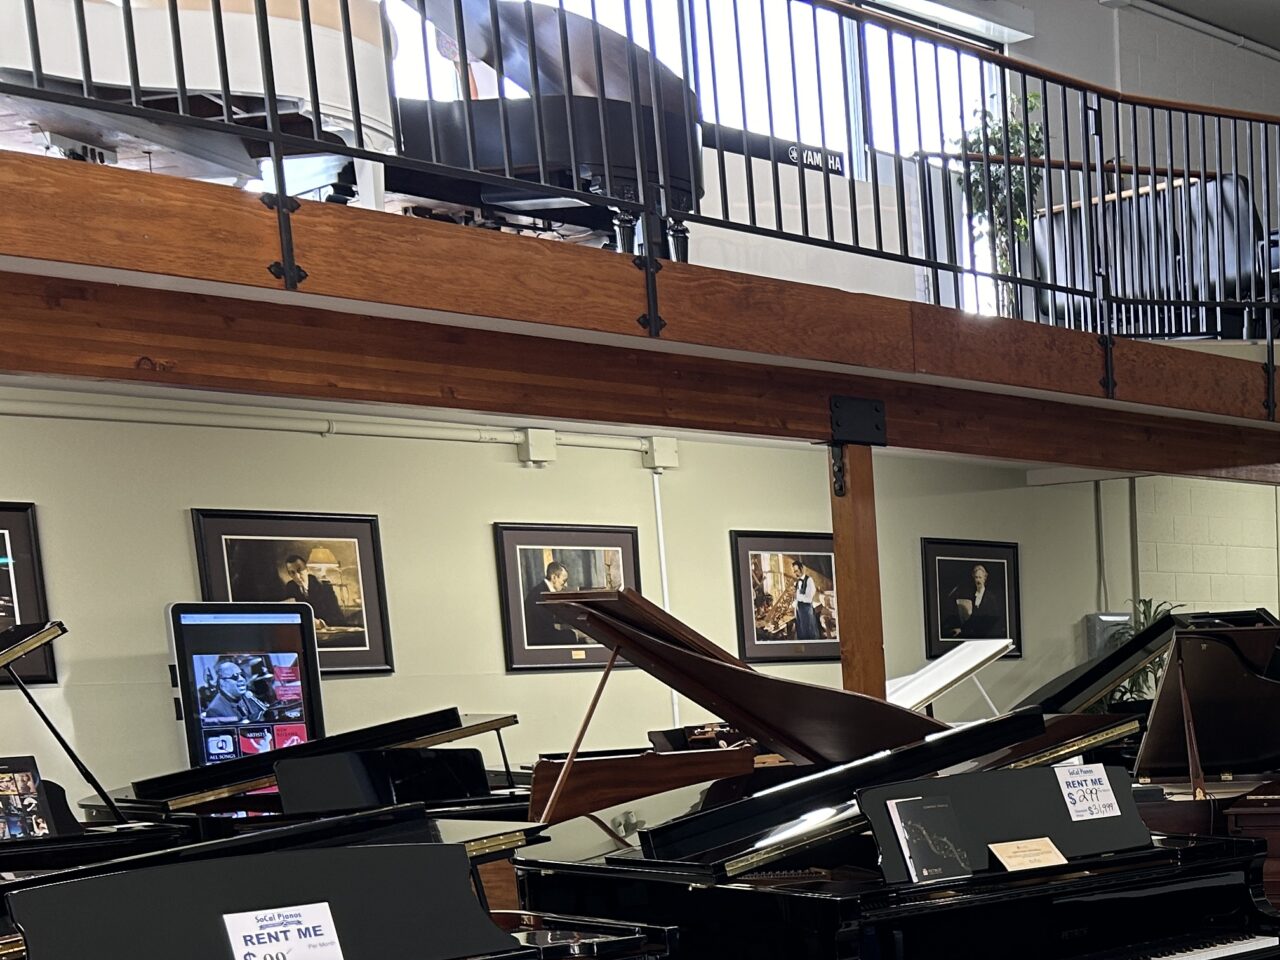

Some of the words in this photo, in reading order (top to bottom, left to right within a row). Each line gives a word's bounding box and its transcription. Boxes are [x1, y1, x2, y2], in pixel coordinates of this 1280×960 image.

[801, 150, 842, 172] YAMHA
[1065, 780, 1088, 789] RENT
[1090, 778, 1104, 786] ME
[254, 913, 276, 924] SoCal
[277, 911, 302, 921] Pianos
[242, 929, 291, 947] RENT
[297, 925, 324, 939] ME
